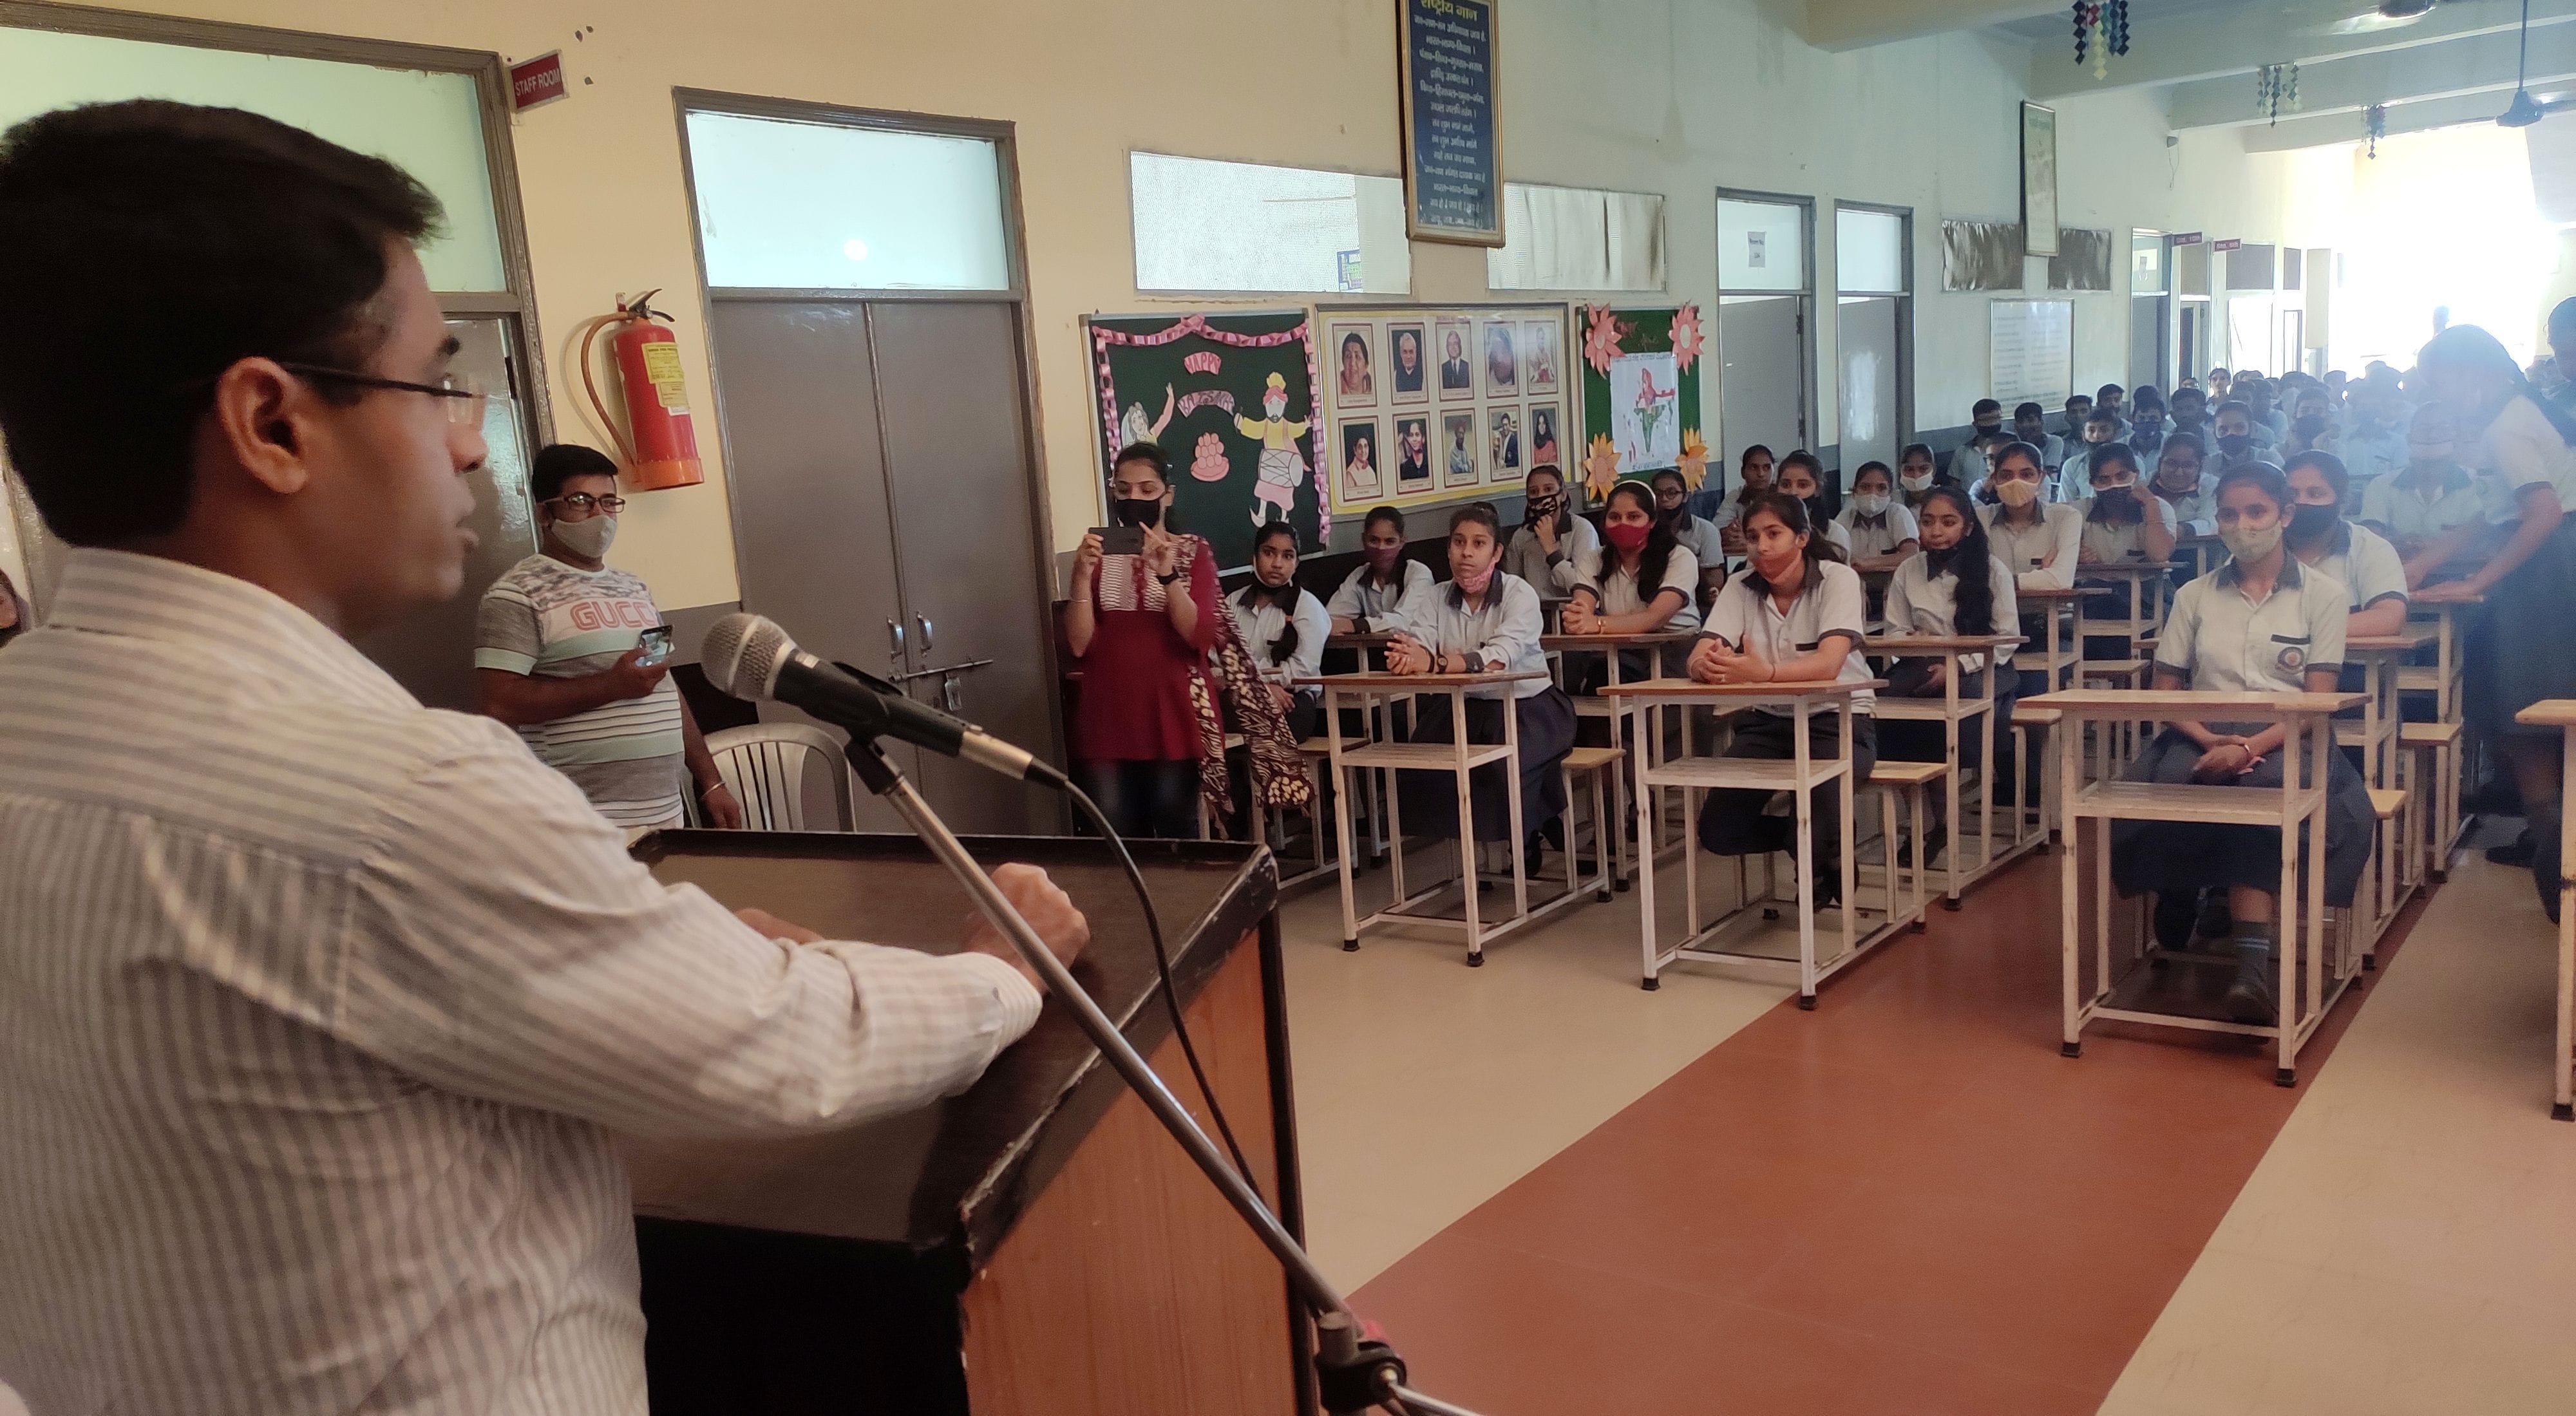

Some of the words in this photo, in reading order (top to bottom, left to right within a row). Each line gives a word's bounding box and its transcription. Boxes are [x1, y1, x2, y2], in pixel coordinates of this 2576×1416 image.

[1456, 6, 1477, 21] गान
[515, 75, 536, 97] STAFF
[537, 68, 561, 89] ROOM
[1185, 352, 1220, 373] HAPPY
[570, 601, 656, 631] GUCC
